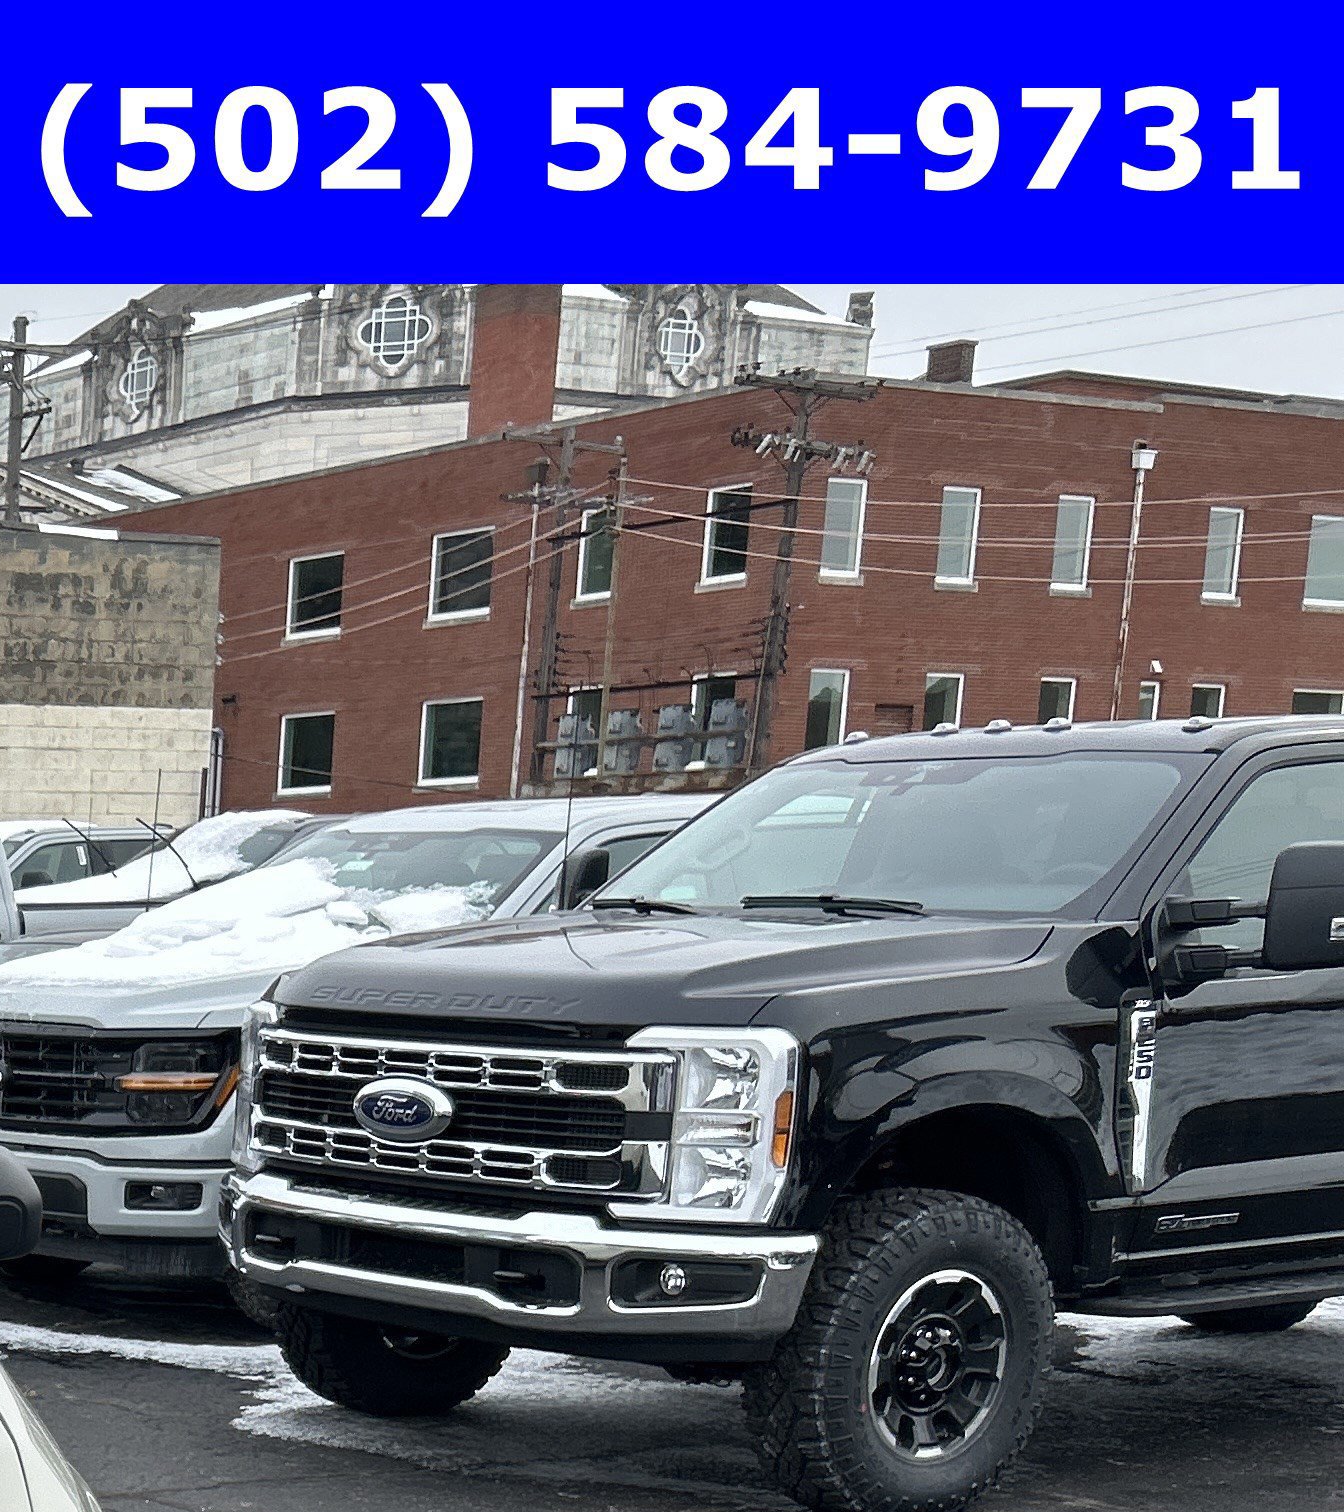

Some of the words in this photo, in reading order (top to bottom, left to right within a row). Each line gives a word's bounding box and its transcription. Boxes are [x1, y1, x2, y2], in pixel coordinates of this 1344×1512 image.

[310, 985, 442, 1010] SUPER
[446, 993, 582, 1015] DUTY
[372, 1095, 418, 1122] Ford
